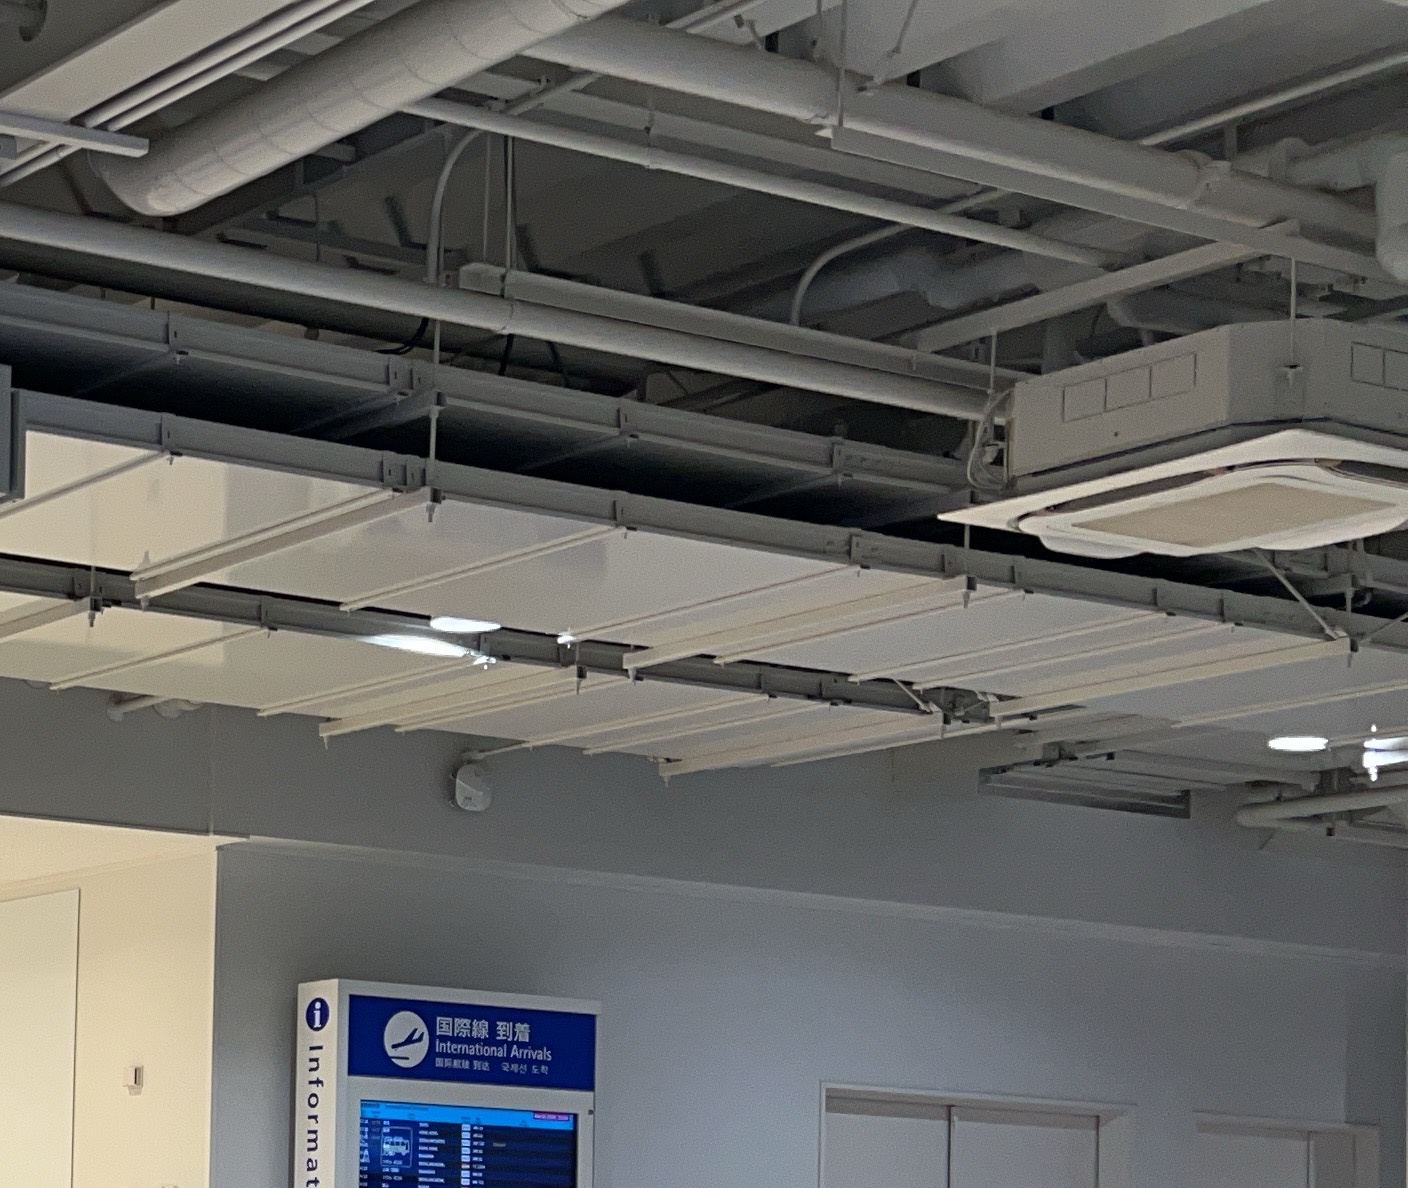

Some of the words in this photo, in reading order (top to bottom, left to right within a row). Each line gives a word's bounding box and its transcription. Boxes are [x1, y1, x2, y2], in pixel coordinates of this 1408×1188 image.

[436, 1016, 490, 1040] 国際線
[495, 1021, 531, 1043] 到着
[435, 1038, 508, 1058] International
[509, 1044, 553, 1062] Arrivals
